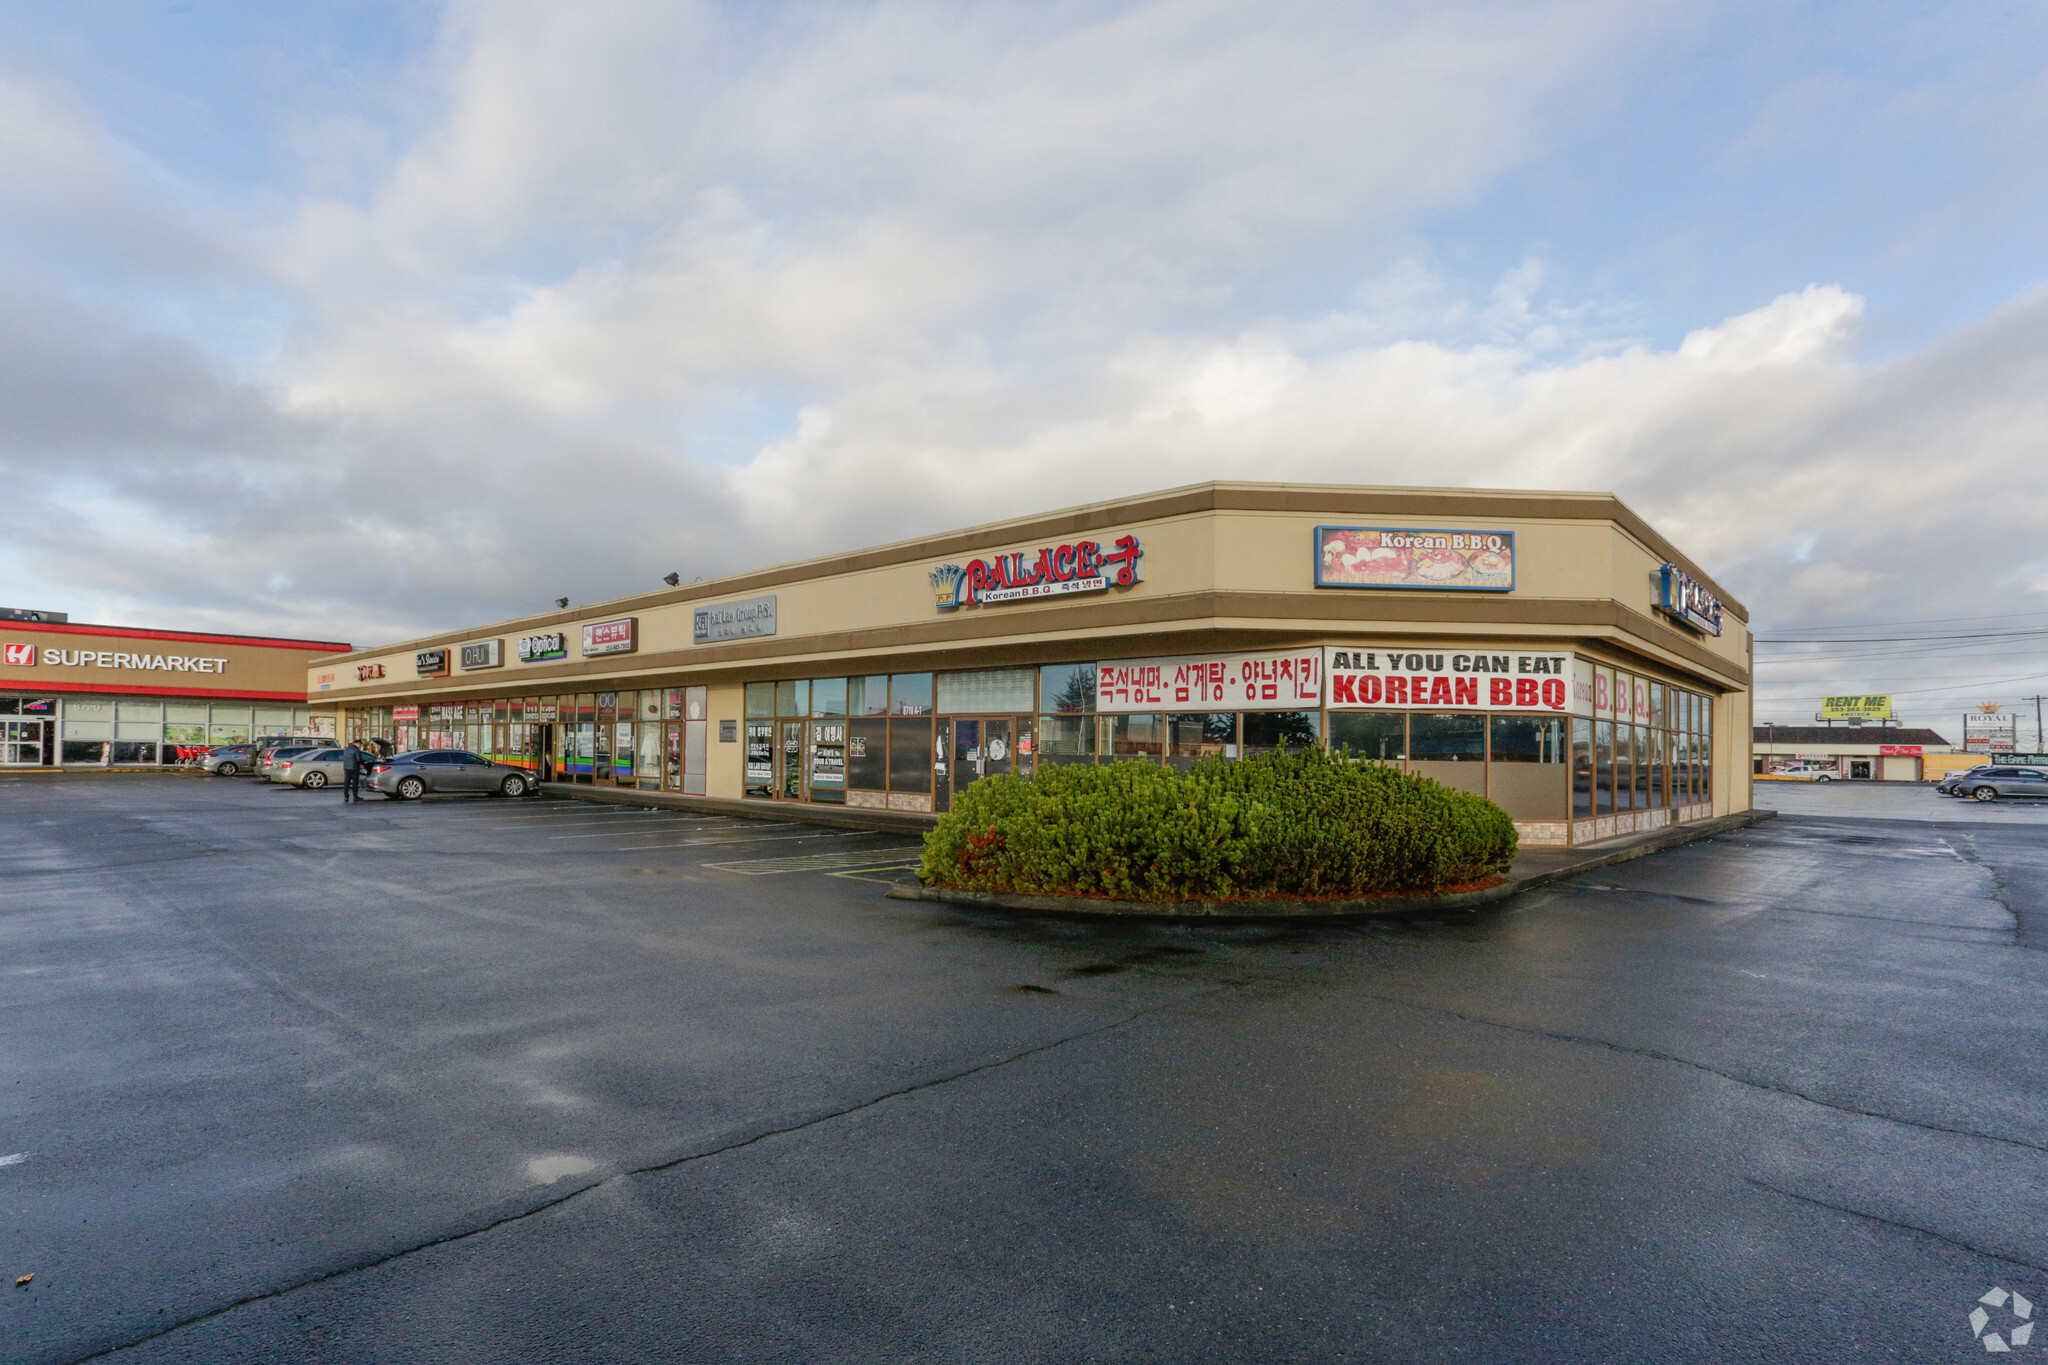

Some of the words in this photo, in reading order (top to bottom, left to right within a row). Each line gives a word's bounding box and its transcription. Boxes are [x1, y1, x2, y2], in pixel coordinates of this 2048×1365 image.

[1380, 533, 1447, 550] Korean
[1452, 535, 1506, 553] B.B.Q.
[965, 540, 1099, 604] PALACE
[985, 590, 1020, 601] Korean
[1022, 585, 1054, 597] B.B.Q.
[1062, 580, 1080, 591] 즉석
[1082, 578, 1103, 589] 냉면
[532, 633, 561, 656] Optical
[43, 648, 228, 674] SUPERMARKET
[1333, 652, 1380, 671] ALL
[1386, 653, 1444, 672] YOU
[1452, 654, 1510, 673] CAN
[1518, 656, 1566, 674] EAT
[1100, 665, 1161, 703] 즉석냉면
[1174, 662, 1226, 702] 삼계탕
[1242, 656, 1318, 701] 양념치킨
[1333, 675, 1478, 705] KOREAN
[1490, 677, 1566, 710] BBQ
[1825, 696, 1862, 707] RENT
[1863, 696, 1887, 707] ME
